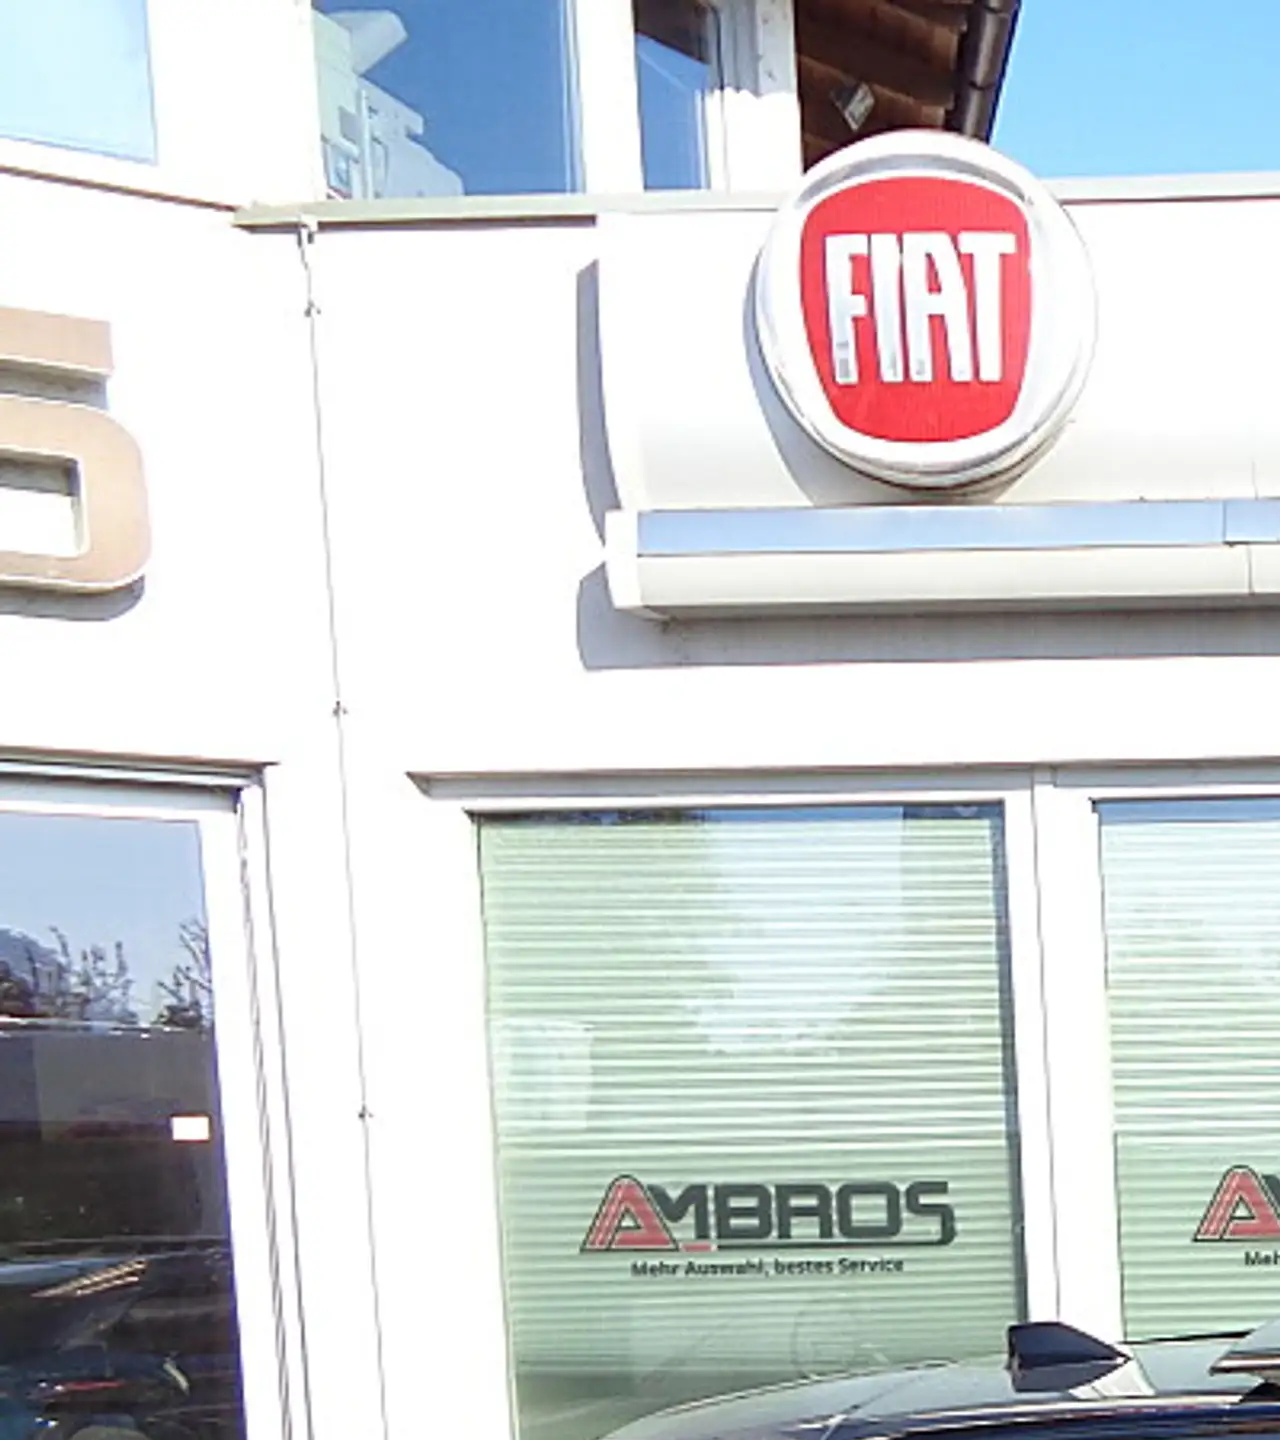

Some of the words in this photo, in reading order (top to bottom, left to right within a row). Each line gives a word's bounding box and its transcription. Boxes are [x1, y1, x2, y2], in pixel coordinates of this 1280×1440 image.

[823, 231, 1018, 385] FIAT
[581, 1173, 957, 1250] AMBROS
[631, 1261, 679, 1277] Mehr
[684, 1259, 770, 1278] Auswahl,
[774, 1258, 833, 1275] bestes
[838, 1257, 905, 1274] Service
